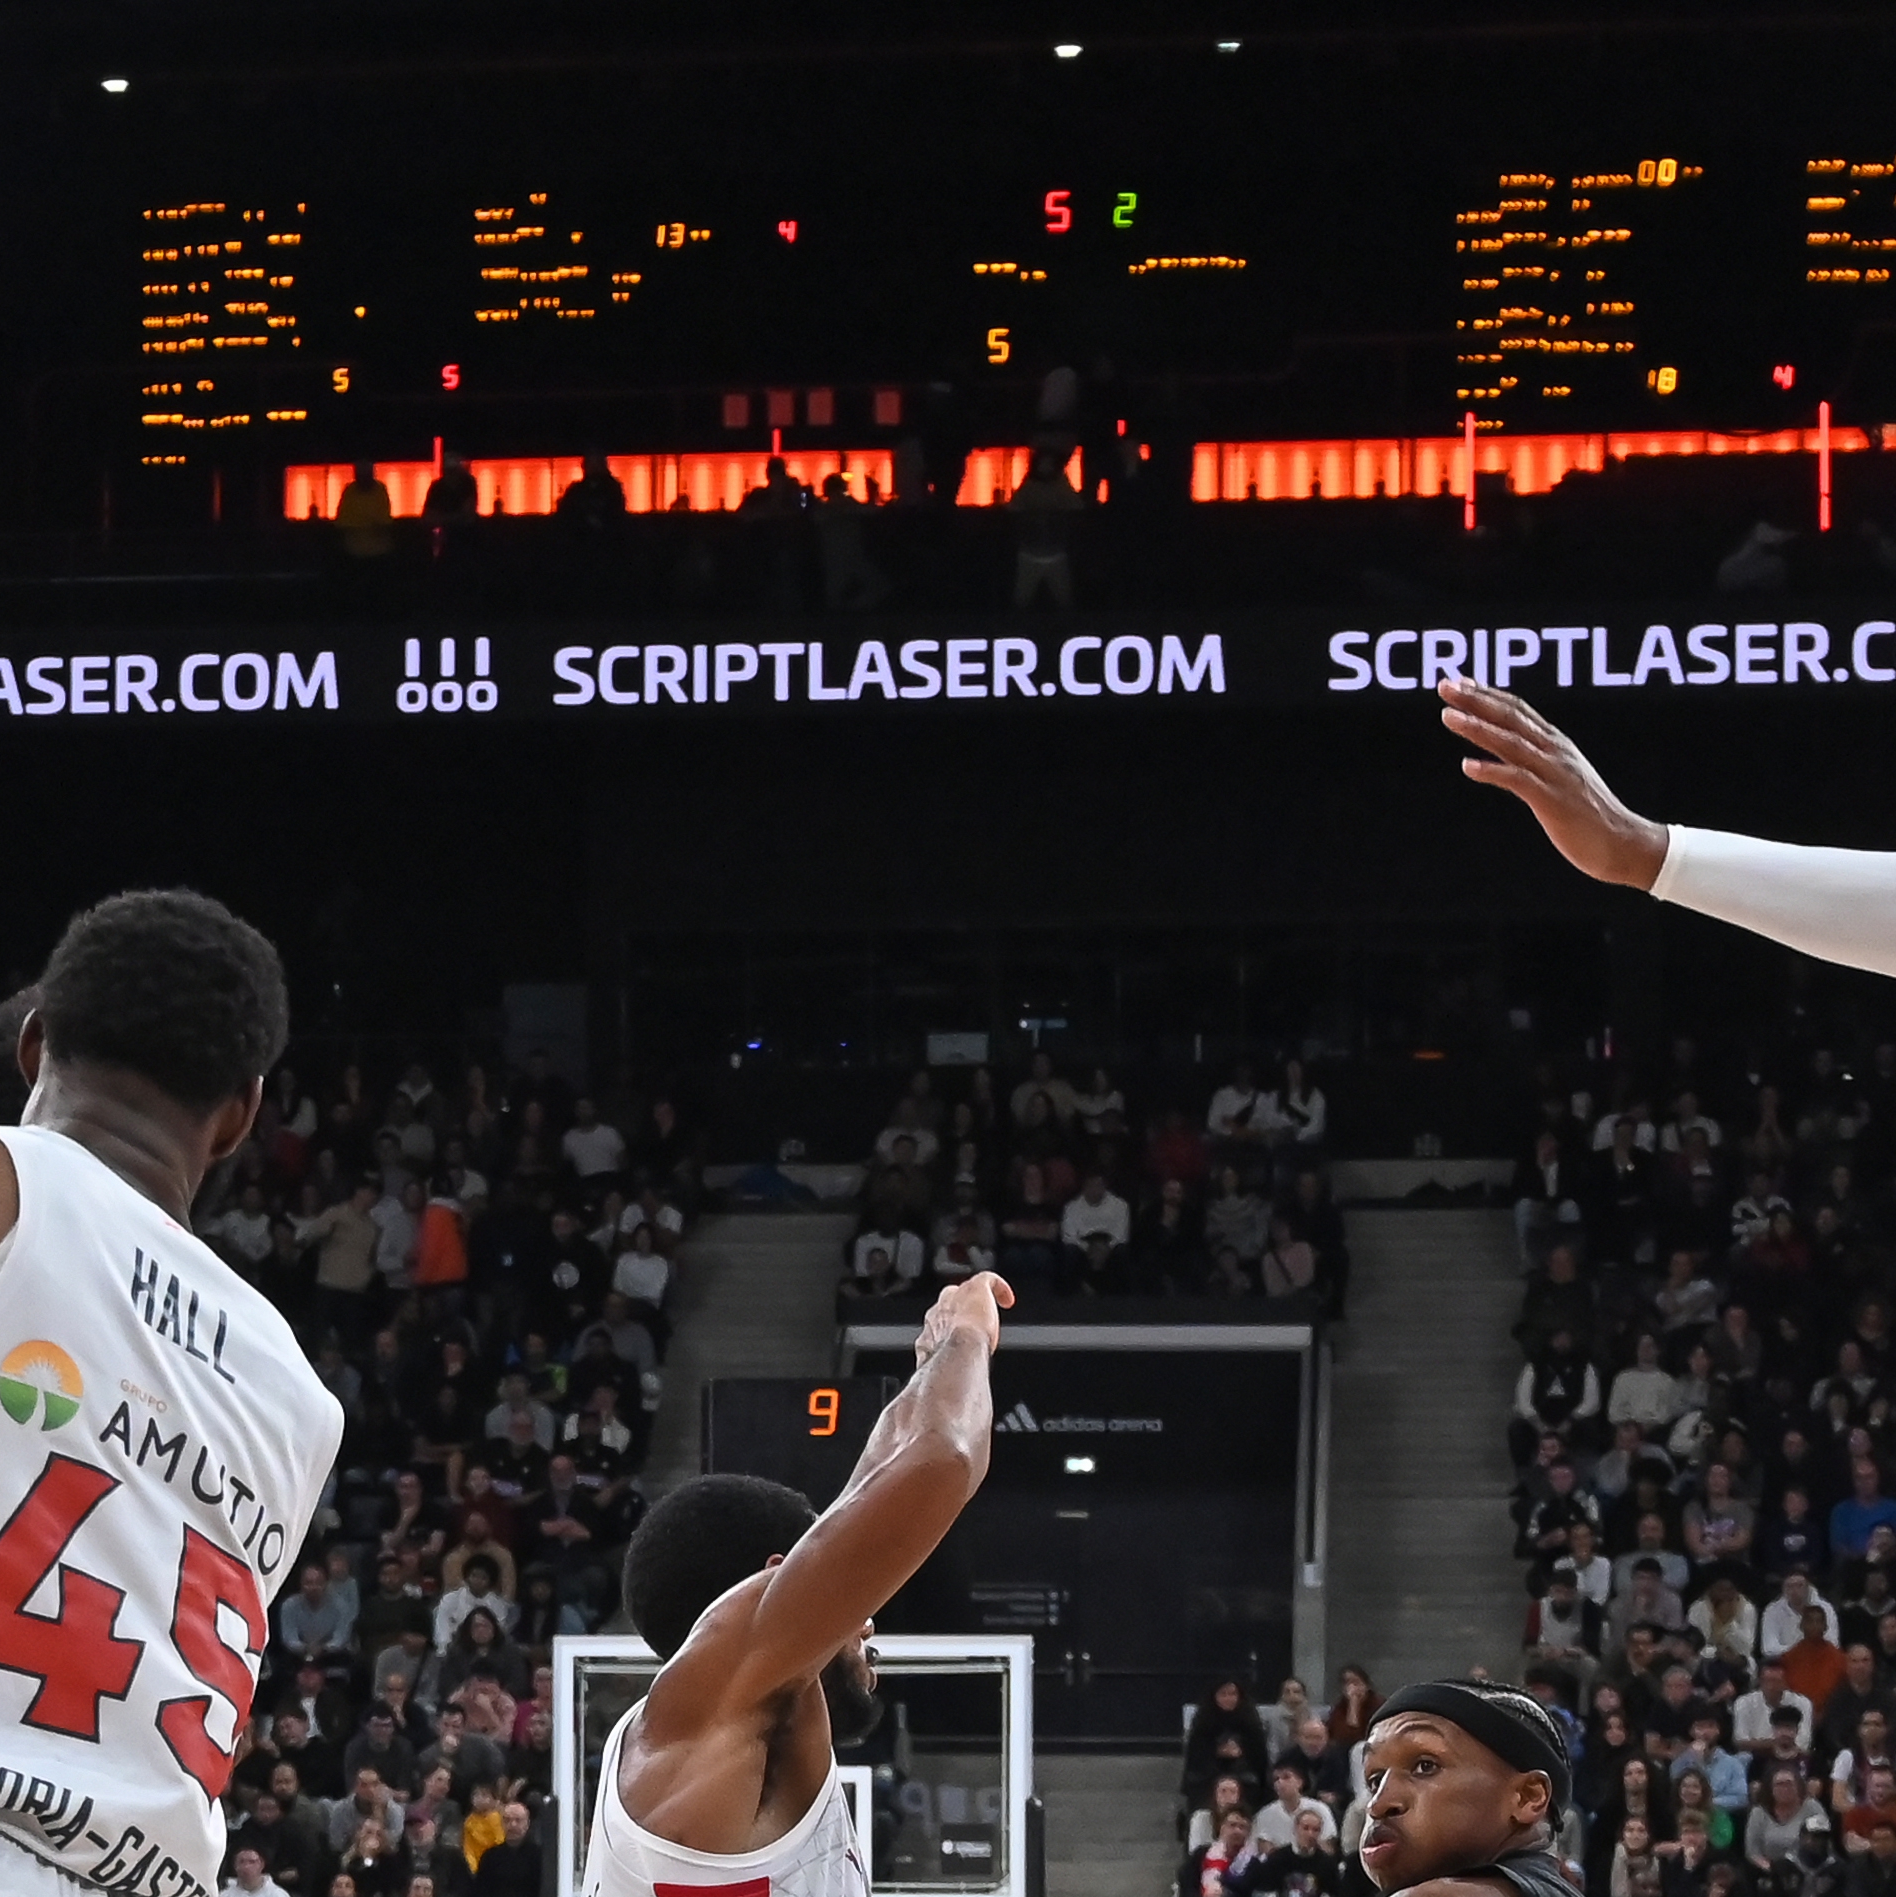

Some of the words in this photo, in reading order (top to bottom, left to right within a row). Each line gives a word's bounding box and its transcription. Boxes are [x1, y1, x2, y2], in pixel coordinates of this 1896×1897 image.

[1044, 189, 1072, 234] 5
[1112, 192, 1138, 229] 2
[655, 222, 686, 249] 13
[777, 220, 798, 244] 4
[986, 327, 1011, 364] 5
[332, 367, 350, 393] 5
[441, 363, 461, 391] 5
[553, 634, 1225, 705] SCRIPTLASER.COM
[131, 1246, 237, 1385] HALL
[120, 1379, 168, 1413] GRUPO
[808, 1388, 840, 1437] 9
[1042, 1415, 1105, 1434] adidas
[1108, 1416, 1164, 1434] arena
[100, 1400, 286, 1577] AMUTIO
